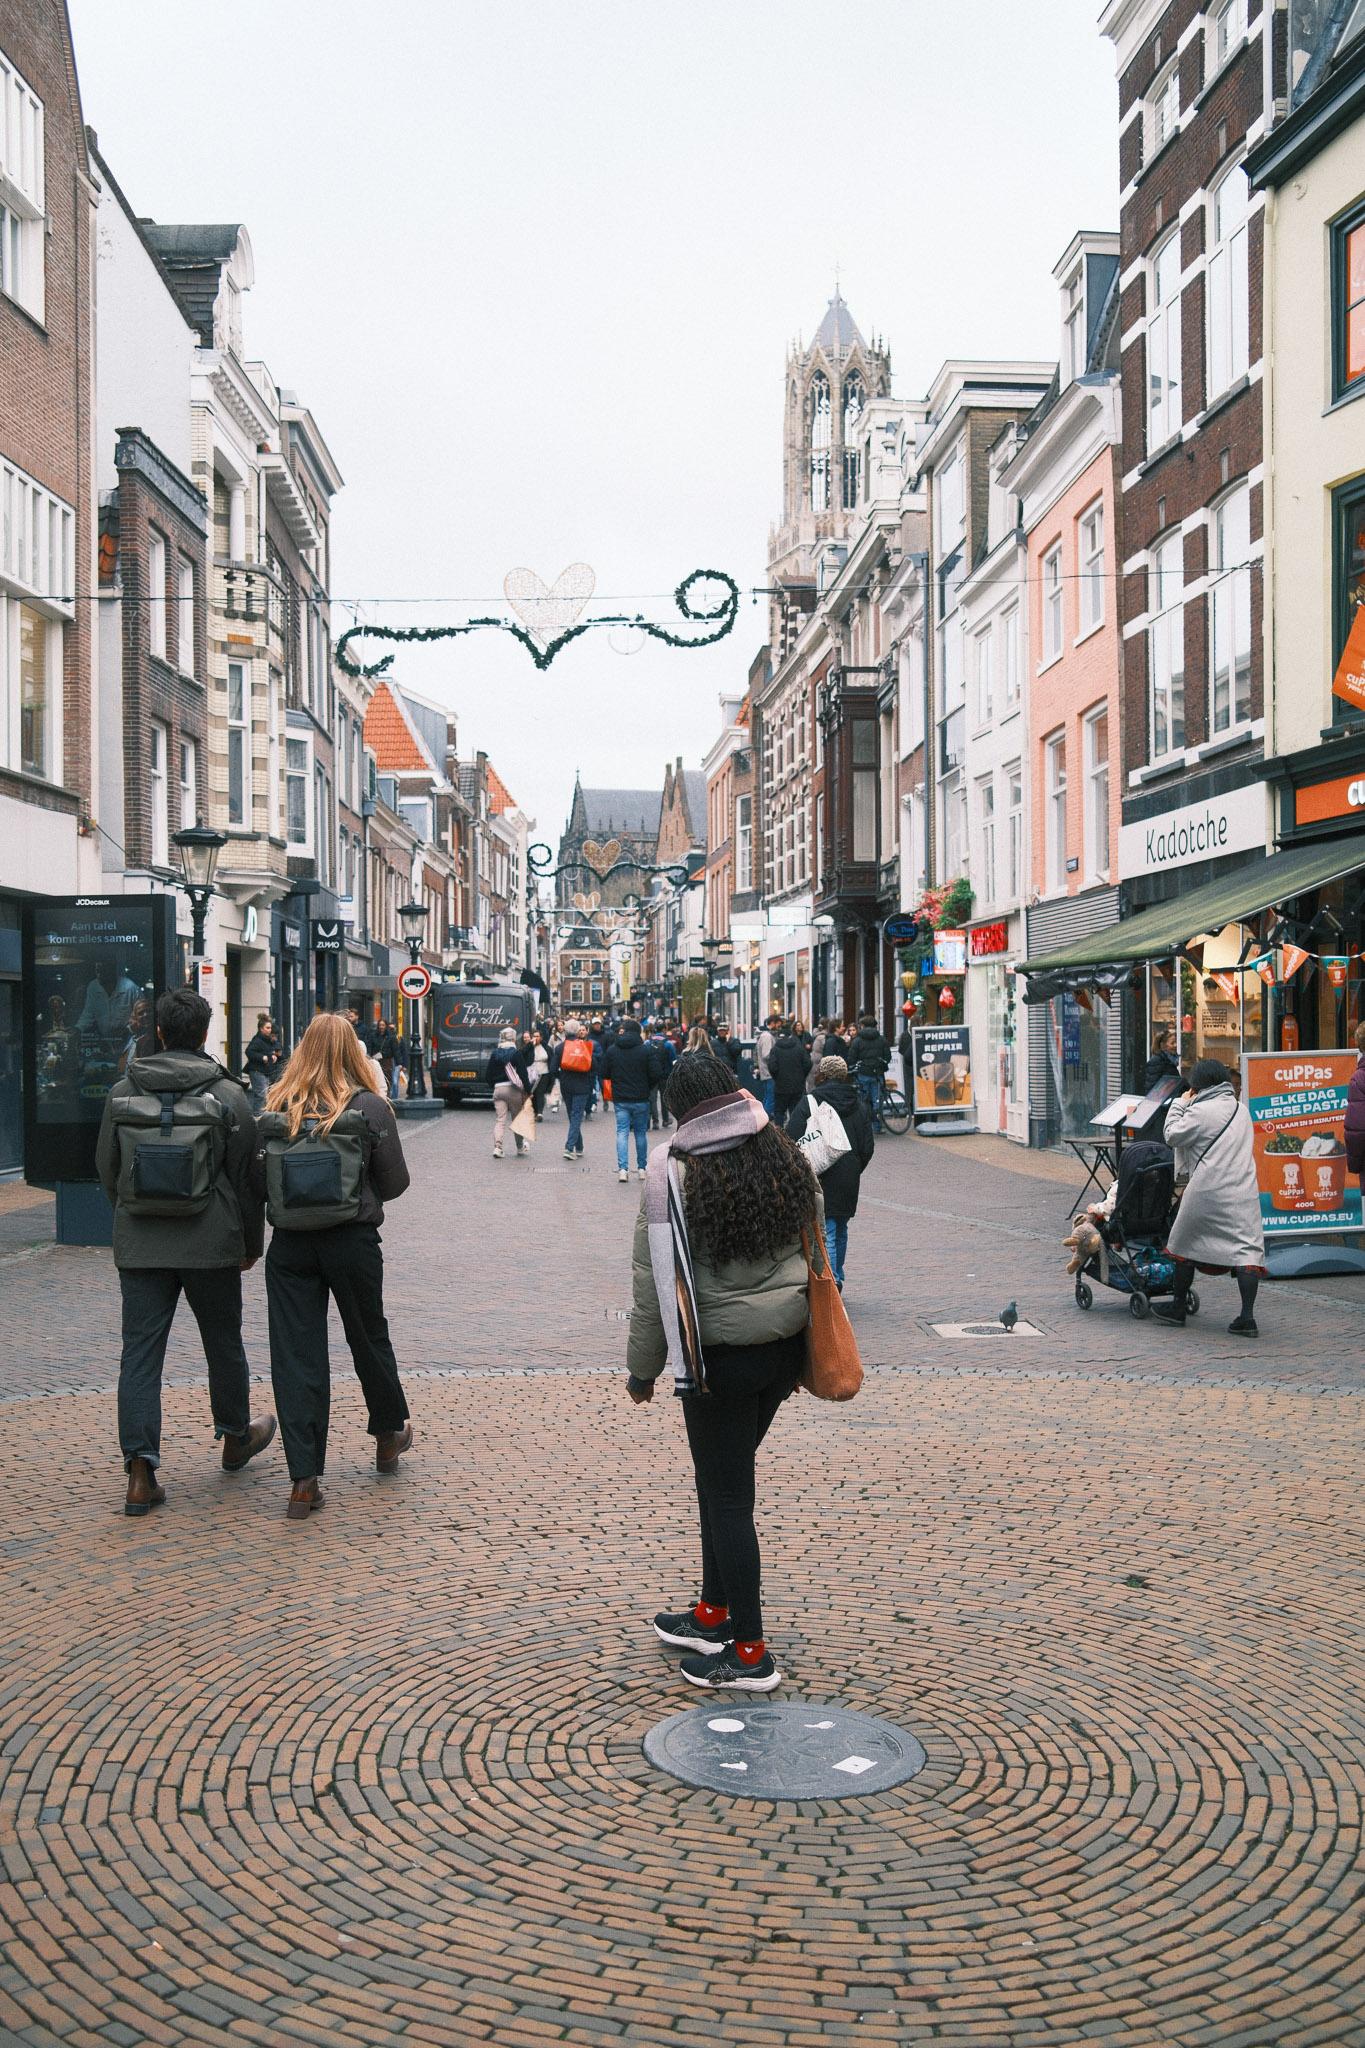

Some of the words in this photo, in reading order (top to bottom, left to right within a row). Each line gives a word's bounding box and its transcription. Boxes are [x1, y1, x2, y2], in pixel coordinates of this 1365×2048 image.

[1146, 809, 1228, 865] Kadotche
[71, 922, 91, 931] Aan
[93, 920, 117, 931] tafel
[49, 934, 77, 944] komt
[79, 934, 102, 943] alles
[104, 934, 138, 943] samen
[462, 1014, 477, 1028] by
[924, 1031, 959, 1040] PHONE
[924, 1043, 963, 1052] REPAIR
[1274, 1065, 1333, 1081] cuPPas
[1270, 1093, 1306, 1106] ELKE
[1308, 1088, 1336, 1102] DAG
[1255, 1105, 1302, 1120] VERSE
[1302, 1098, 1349, 1114] PASTA
[1276, 1122, 1299, 1130] KLAAR
[1313, 1114, 1346, 1125] MINUTEN
[1261, 1212, 1354, 1226] WWW.CUPPAS.EU
